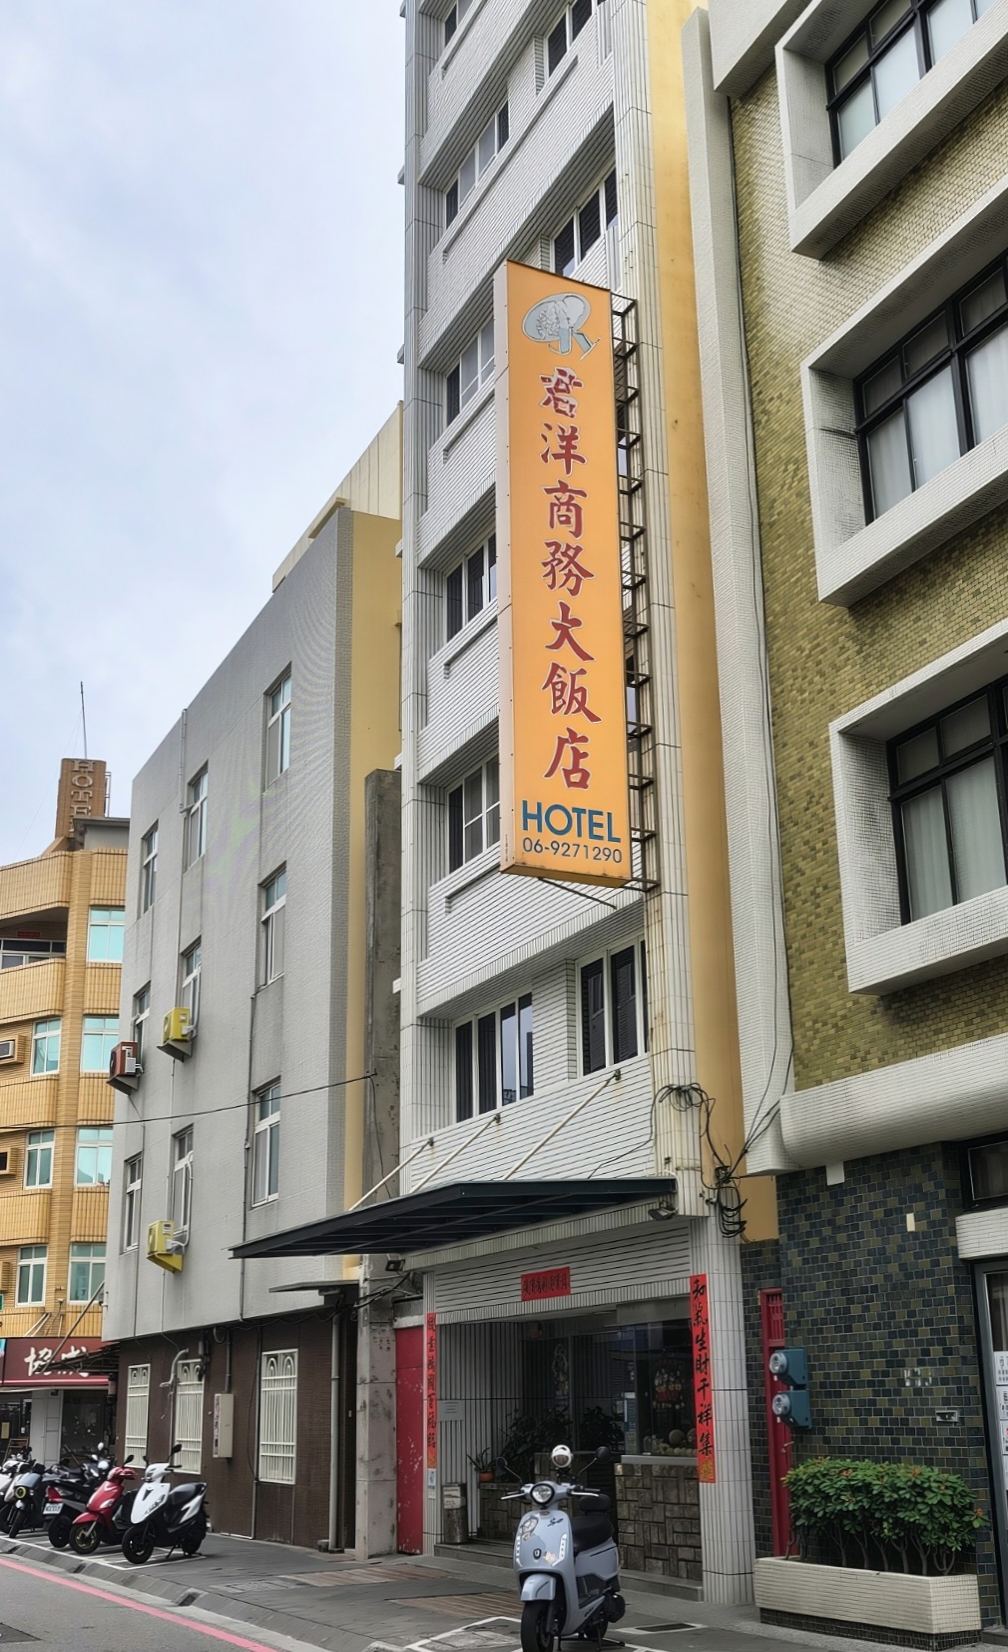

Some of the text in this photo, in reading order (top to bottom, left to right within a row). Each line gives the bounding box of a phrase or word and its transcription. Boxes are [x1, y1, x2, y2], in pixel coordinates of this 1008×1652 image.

[69, 760, 96, 832] HOTE
[522, 800, 622, 844] HOTEL
[523, 837, 623, 864] 06-9271290
